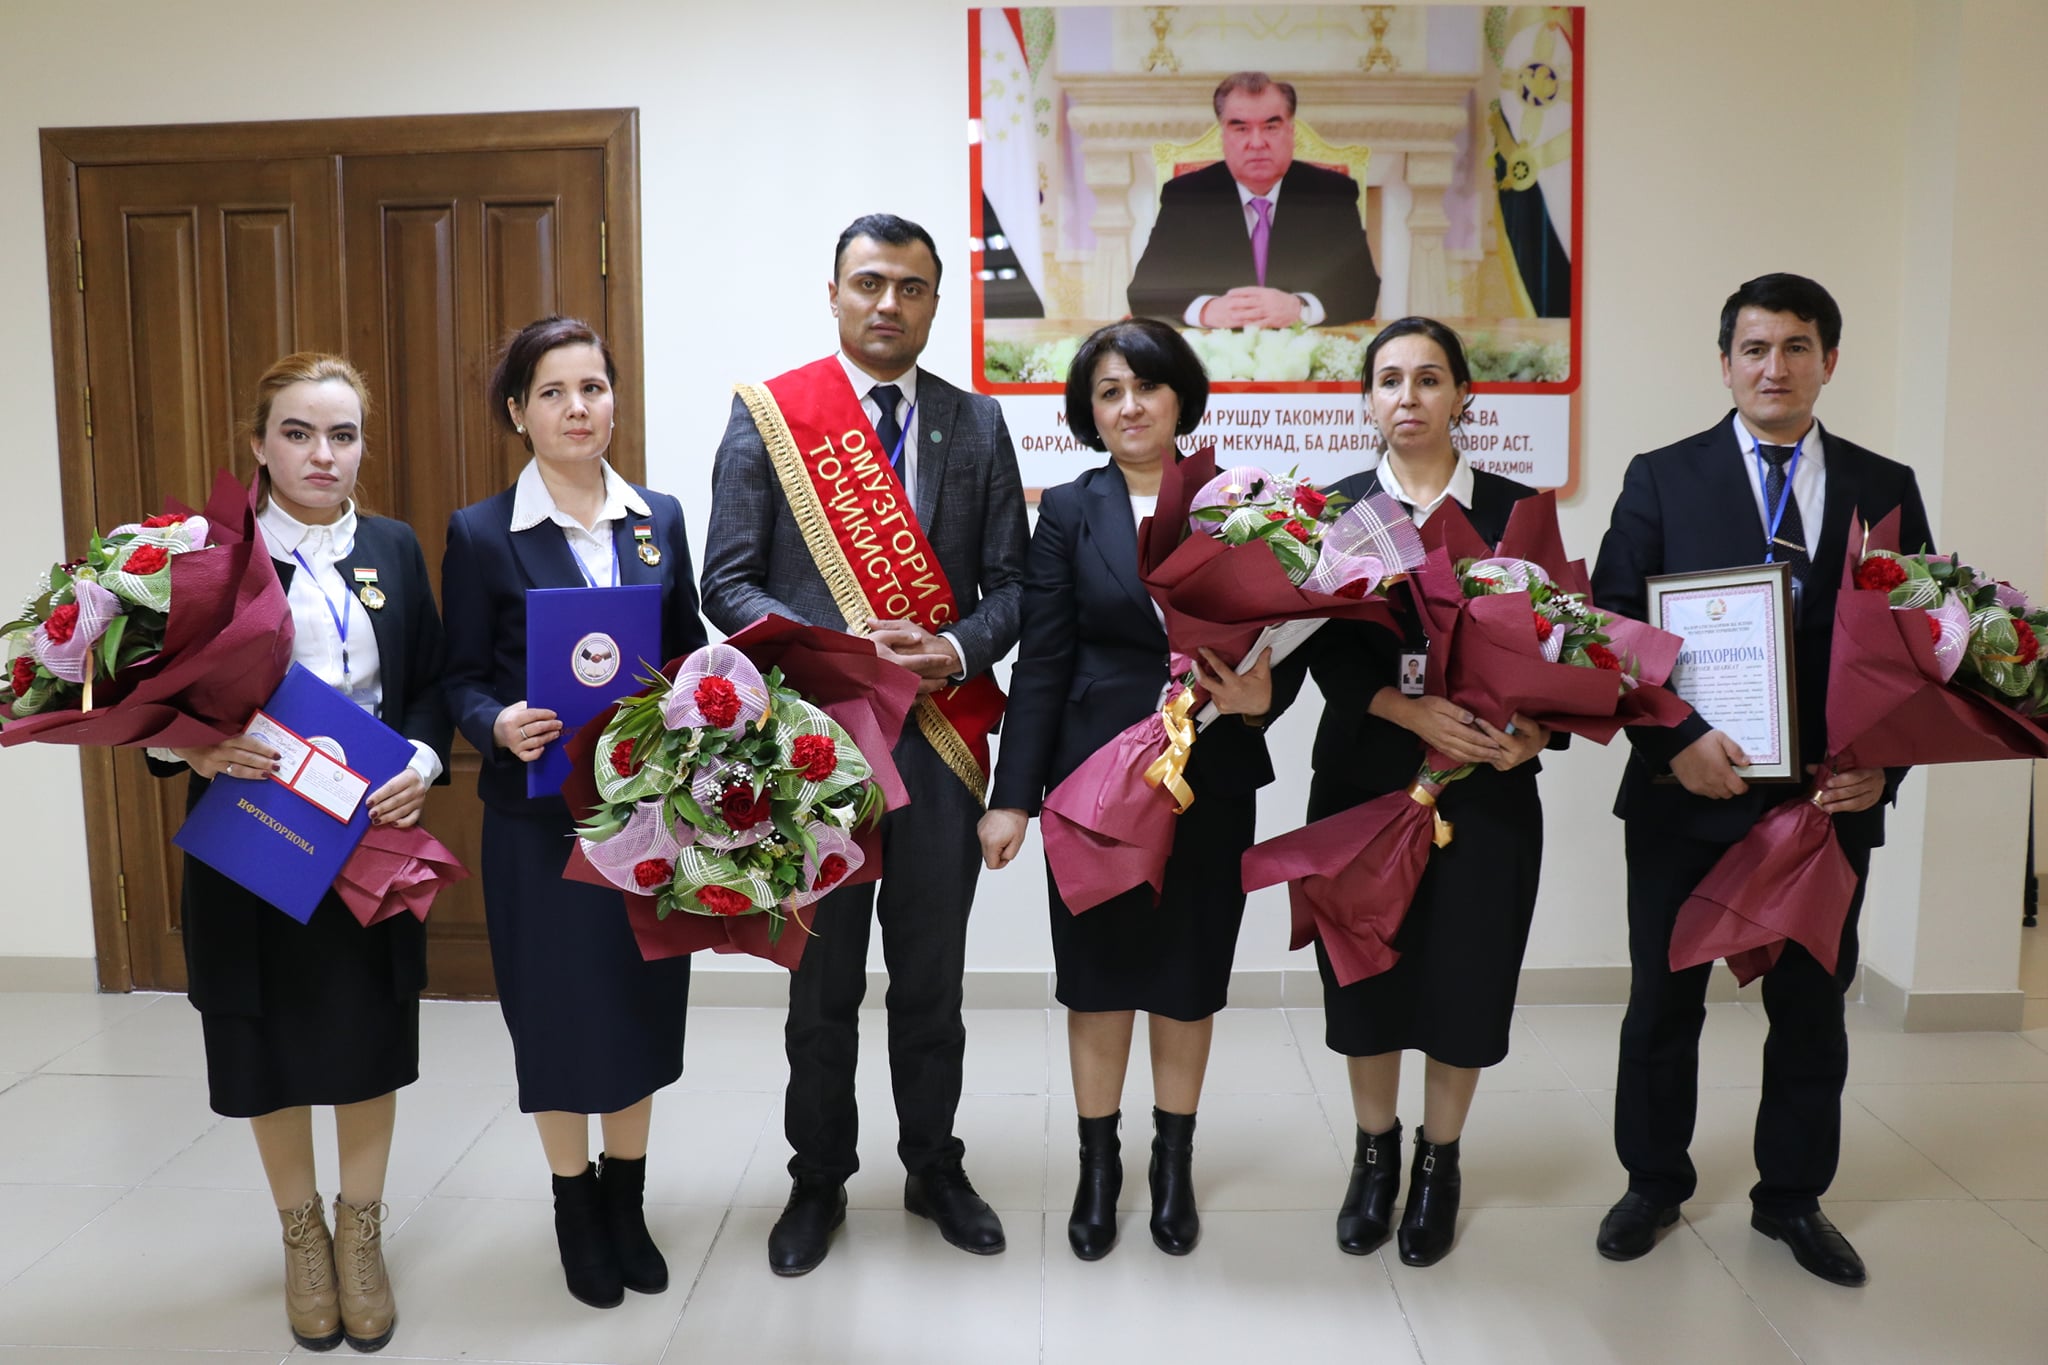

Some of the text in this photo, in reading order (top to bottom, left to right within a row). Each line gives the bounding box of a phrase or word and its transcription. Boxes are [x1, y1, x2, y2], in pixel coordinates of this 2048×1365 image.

[1216, 409, 1271, 428] РУШДУ
[1274, 409, 1355, 426] ТАКОМУЛИ
[1480, 410, 1499, 426] ВА
[1021, 435, 1088, 454] ФАРҲАН
[1175, 434, 1218, 452] ОҲИР
[1223, 434, 1300, 453] МЕКУНАД,
[1305, 434, 1325, 451] БА
[1503, 435, 1533, 452] АСТ.
[1488, 461, 1534, 475] РАҲМОН
[236, 797, 315, 856] ИФТИХОРНОМА
